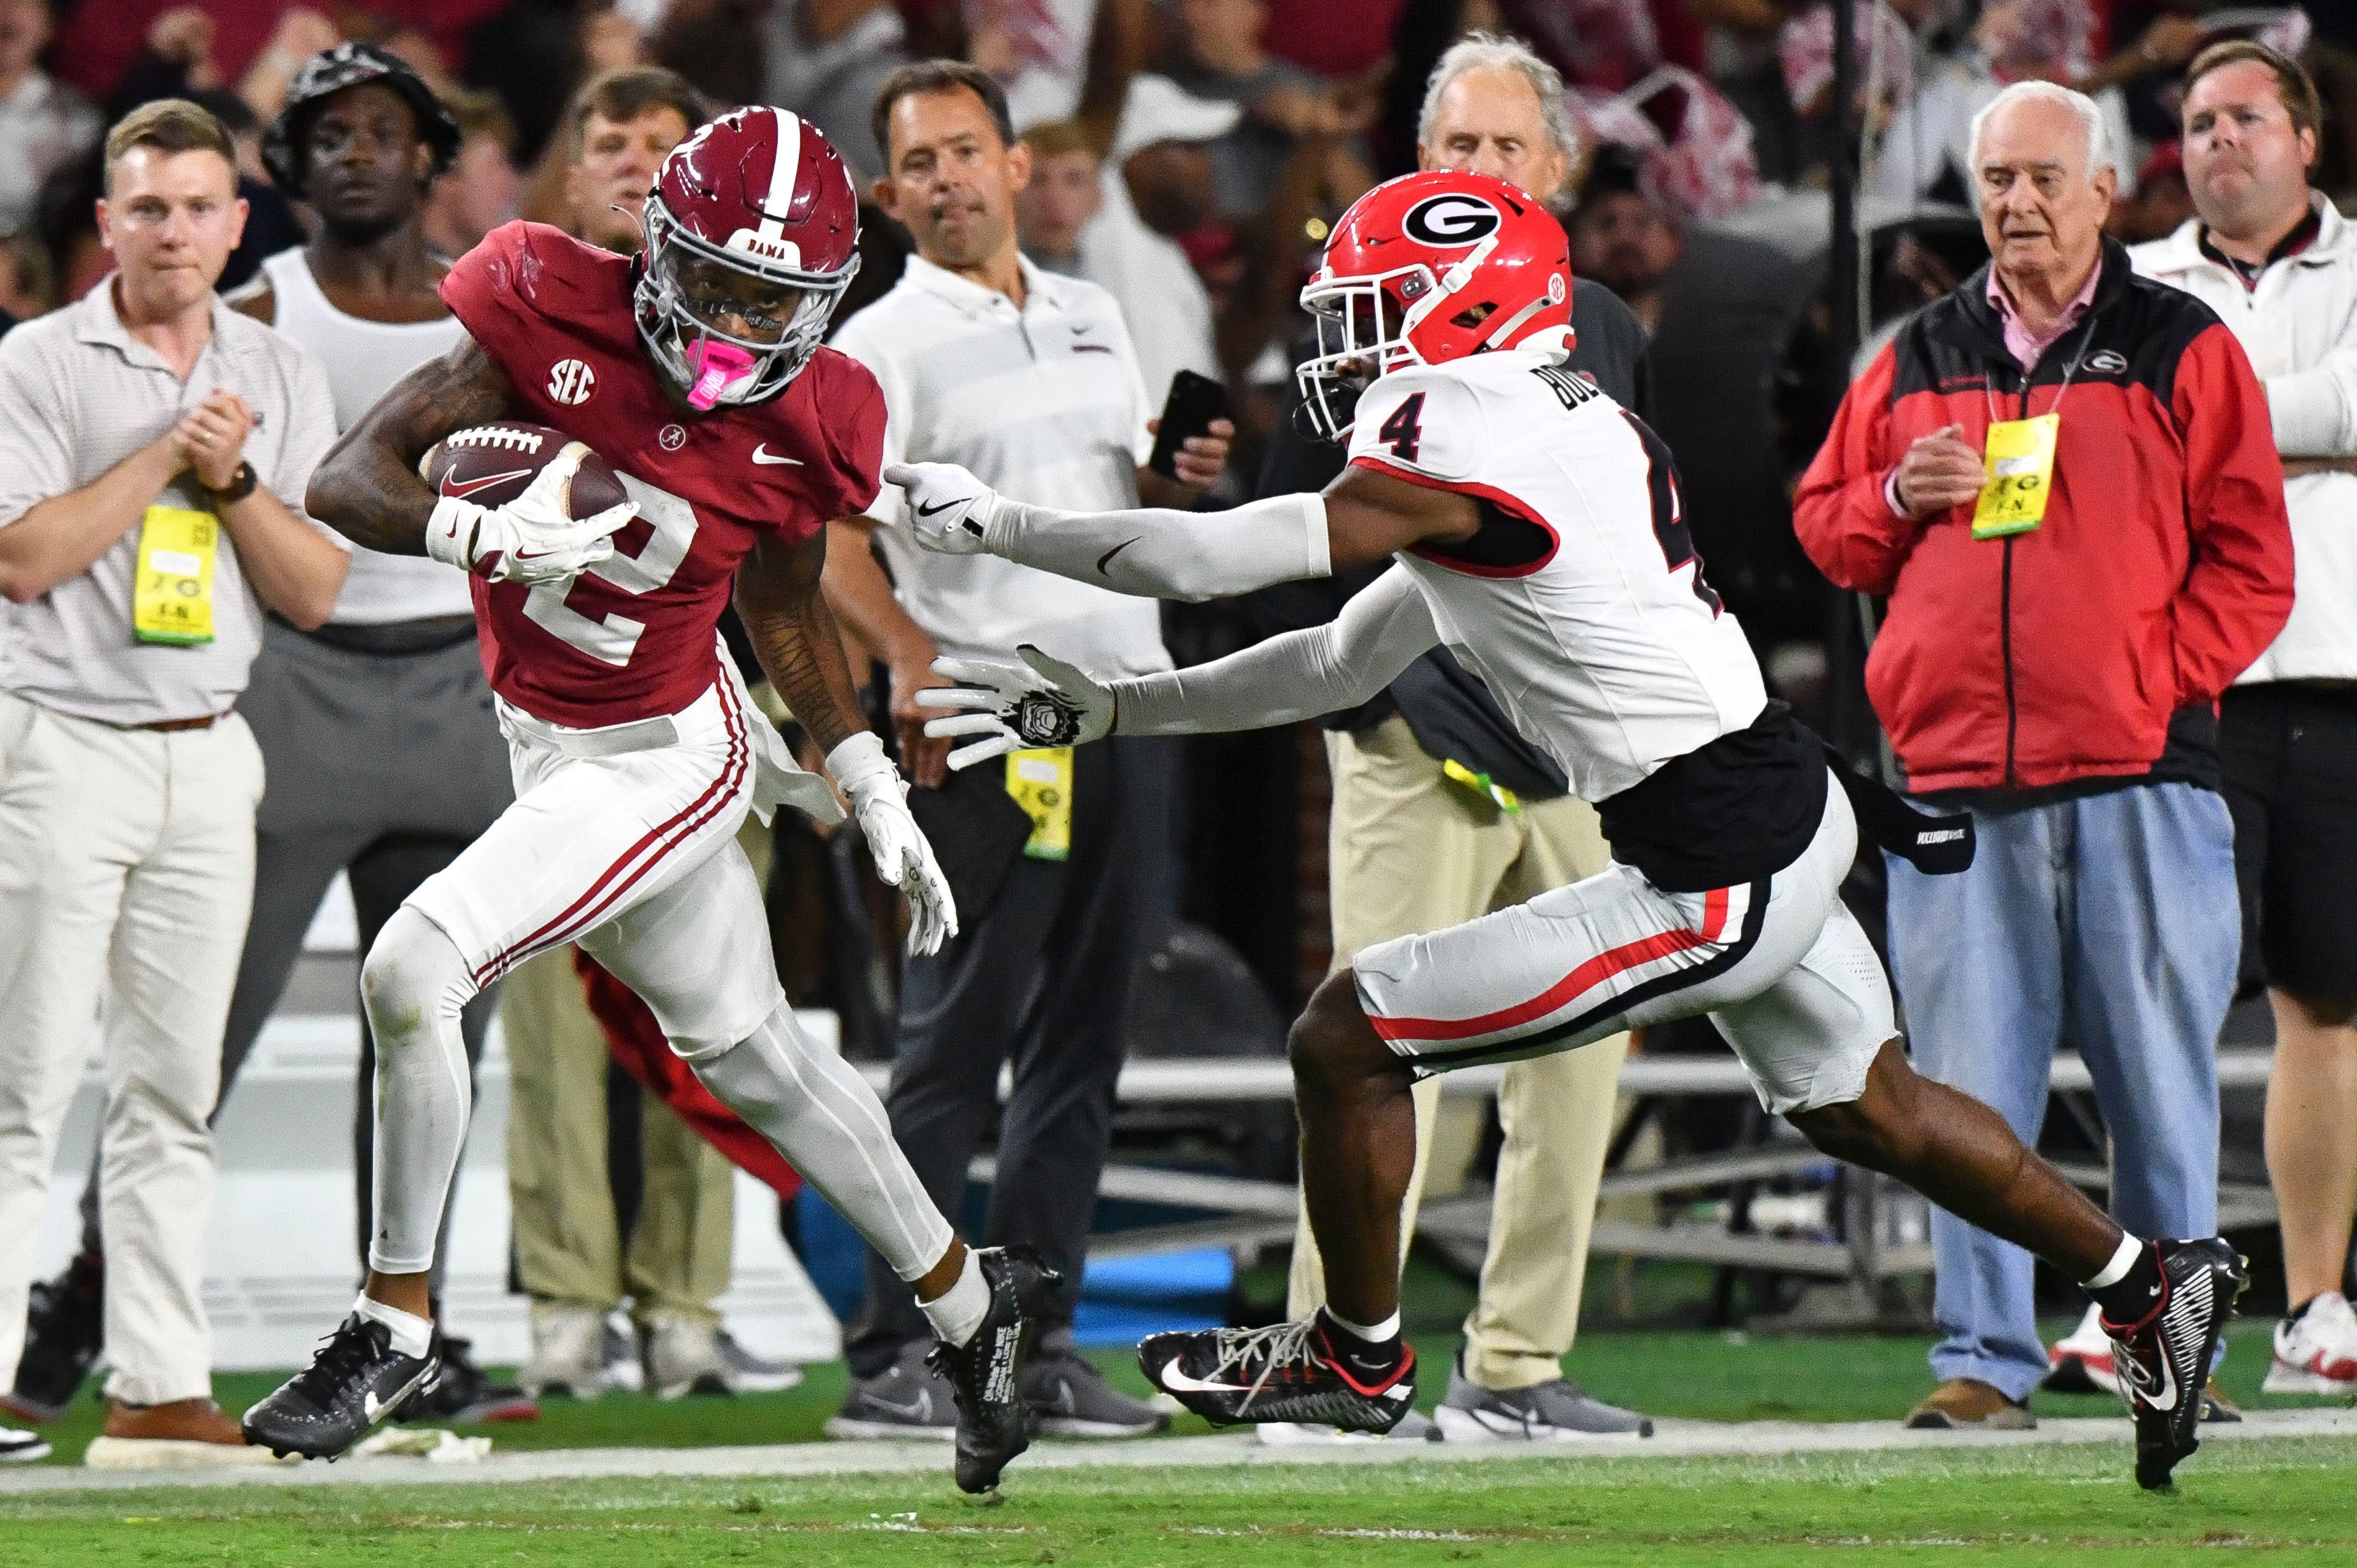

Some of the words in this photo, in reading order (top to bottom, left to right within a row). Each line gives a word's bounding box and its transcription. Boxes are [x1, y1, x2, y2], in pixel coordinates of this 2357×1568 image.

[1405, 194, 1500, 247] G
[747, 238, 785, 259] BAMA
[548, 359, 595, 405] SEC
[1378, 391, 1426, 463] 4
[522, 470, 699, 667] 2
